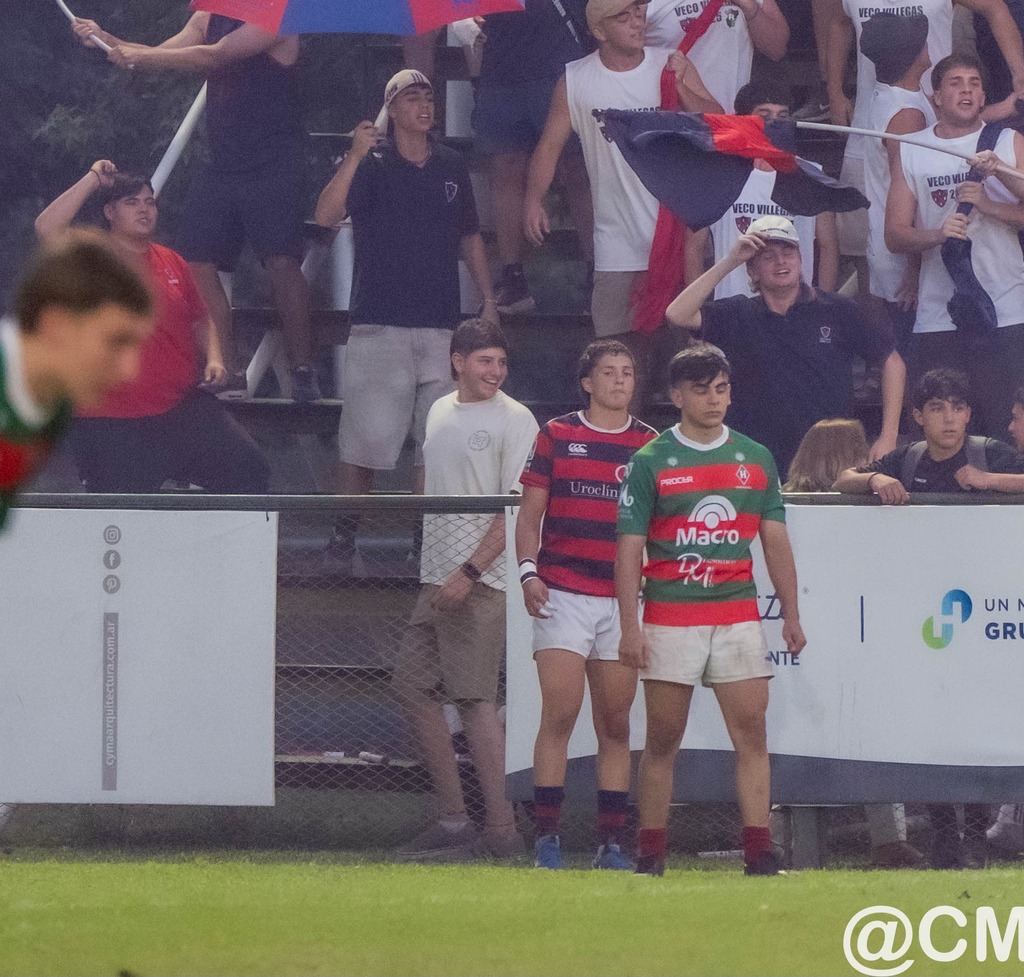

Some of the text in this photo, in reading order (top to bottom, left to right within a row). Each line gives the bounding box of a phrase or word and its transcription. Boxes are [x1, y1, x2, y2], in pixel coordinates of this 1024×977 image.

[674, 2, 700, 17] VECO
[926, 175, 951, 187] VECO
[732, 203, 756, 214] VECO
[570, 481, 618, 498] Uroclín
[675, 526, 740, 547] Macro
[984, 598, 1009, 612] UN
